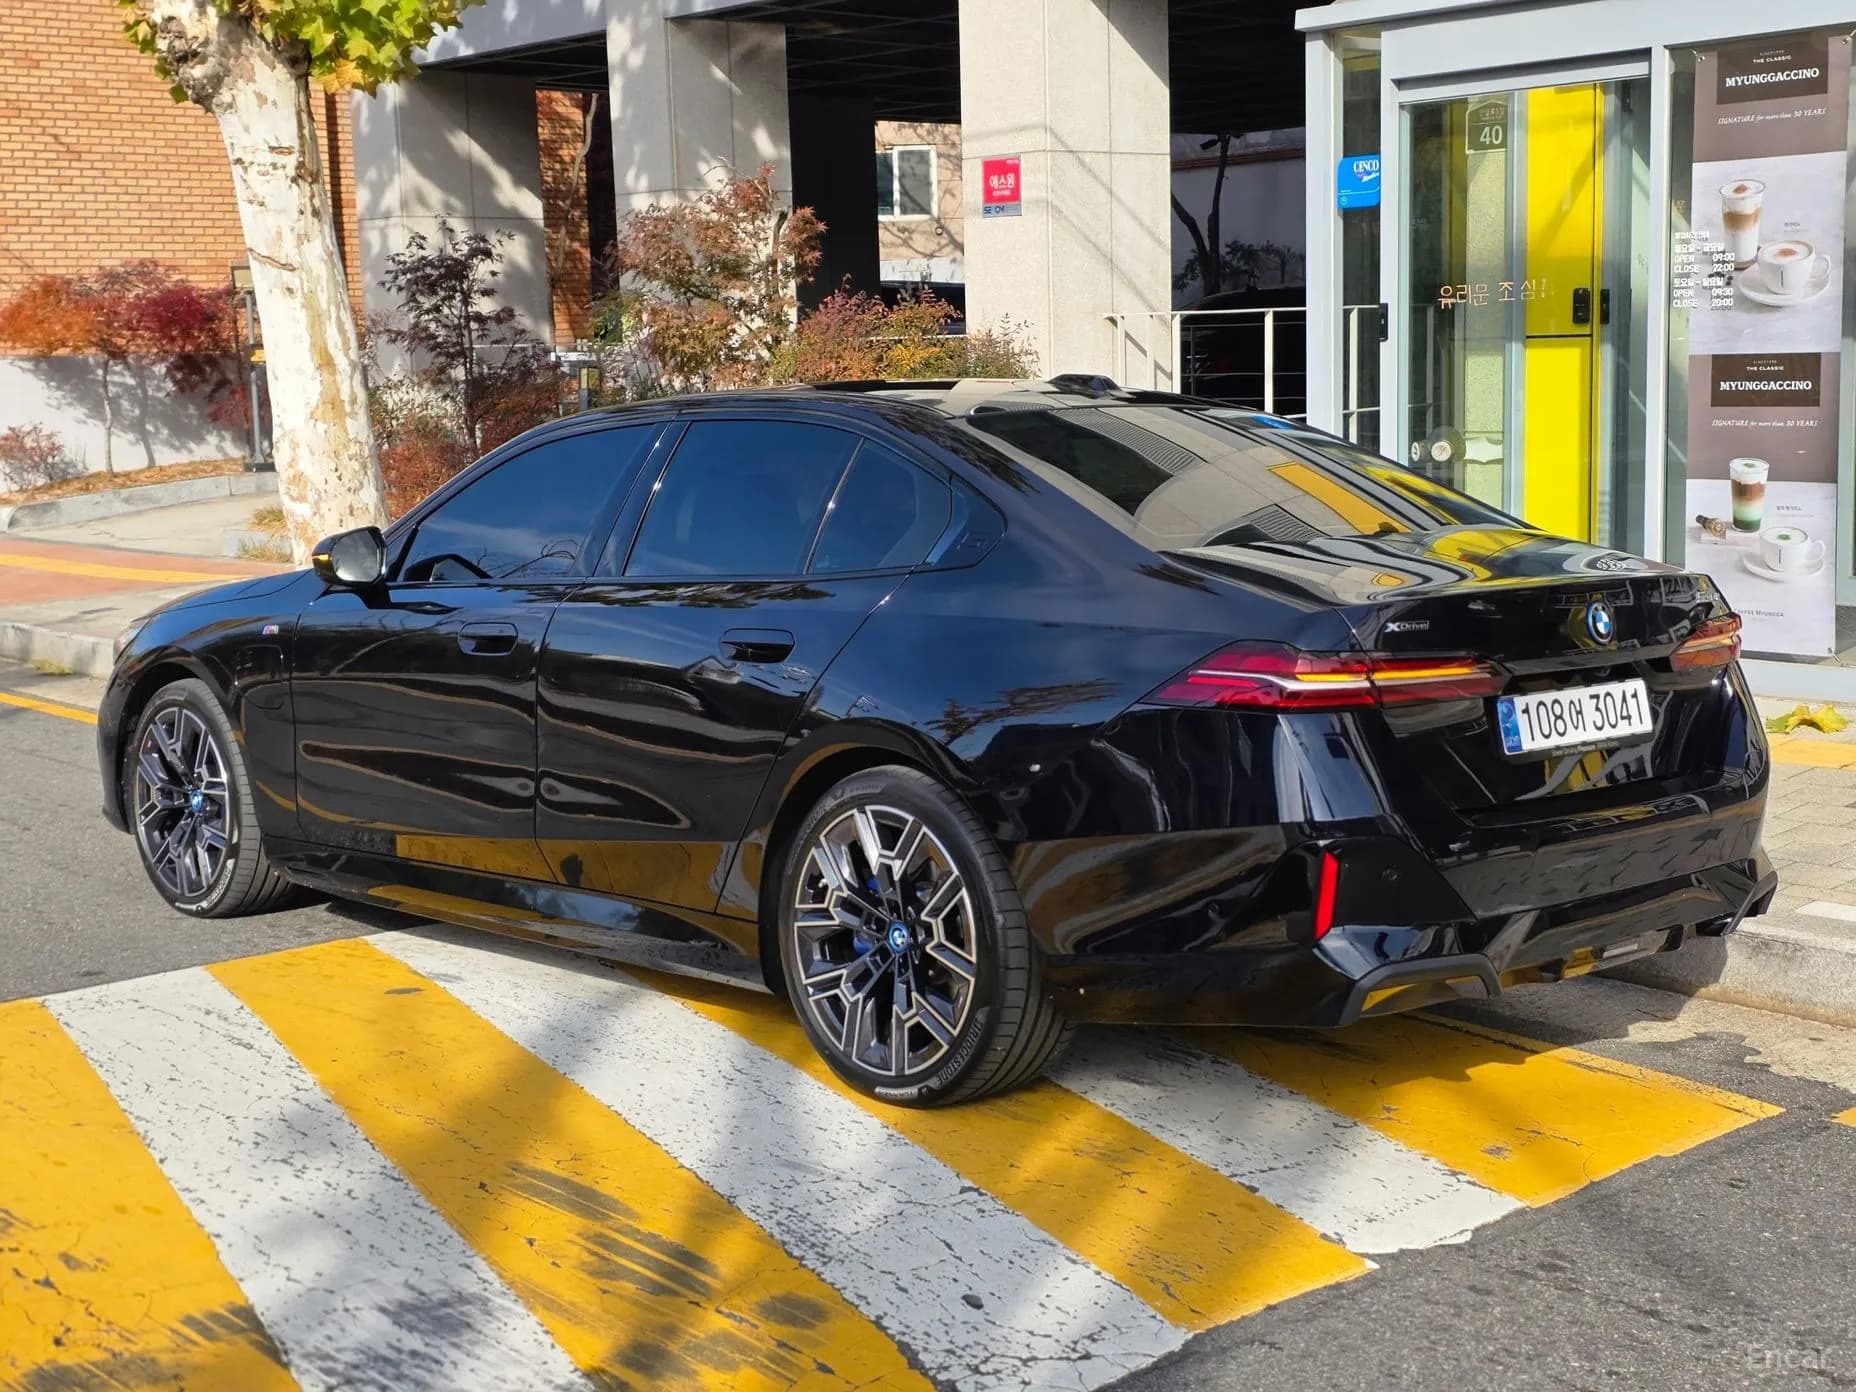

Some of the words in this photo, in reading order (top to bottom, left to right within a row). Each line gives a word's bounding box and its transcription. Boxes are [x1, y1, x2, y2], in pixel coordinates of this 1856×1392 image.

[1725, 68, 1820, 87] MYUNGGACCINO
[1718, 114, 1755, 125] SIGNATURE
[1804, 108, 1826, 117] YEARS
[1480, 124, 1502, 144] 40
[1674, 255, 1694, 263] OPEN
[1712, 253, 1735, 262] 09:00
[1674, 265, 1699, 273] CLOSE
[1712, 263, 1734, 272] 22:00
[1438, 284, 1490, 310] 유리문
[1673, 289, 1694, 297] OPEN
[1712, 288, 1734, 296] 09:30
[1672, 299, 1698, 308] CLOSE
[1712, 298, 1734, 307] 20:00
[1720, 380, 1812, 390] MYUNGGACCINO
[1712, 419, 1748, 427] SIGNATURE
[1796, 419, 1818, 427] YEARS
[1521, 698, 1587, 742] 108어
[1589, 687, 1643, 731] 3041
